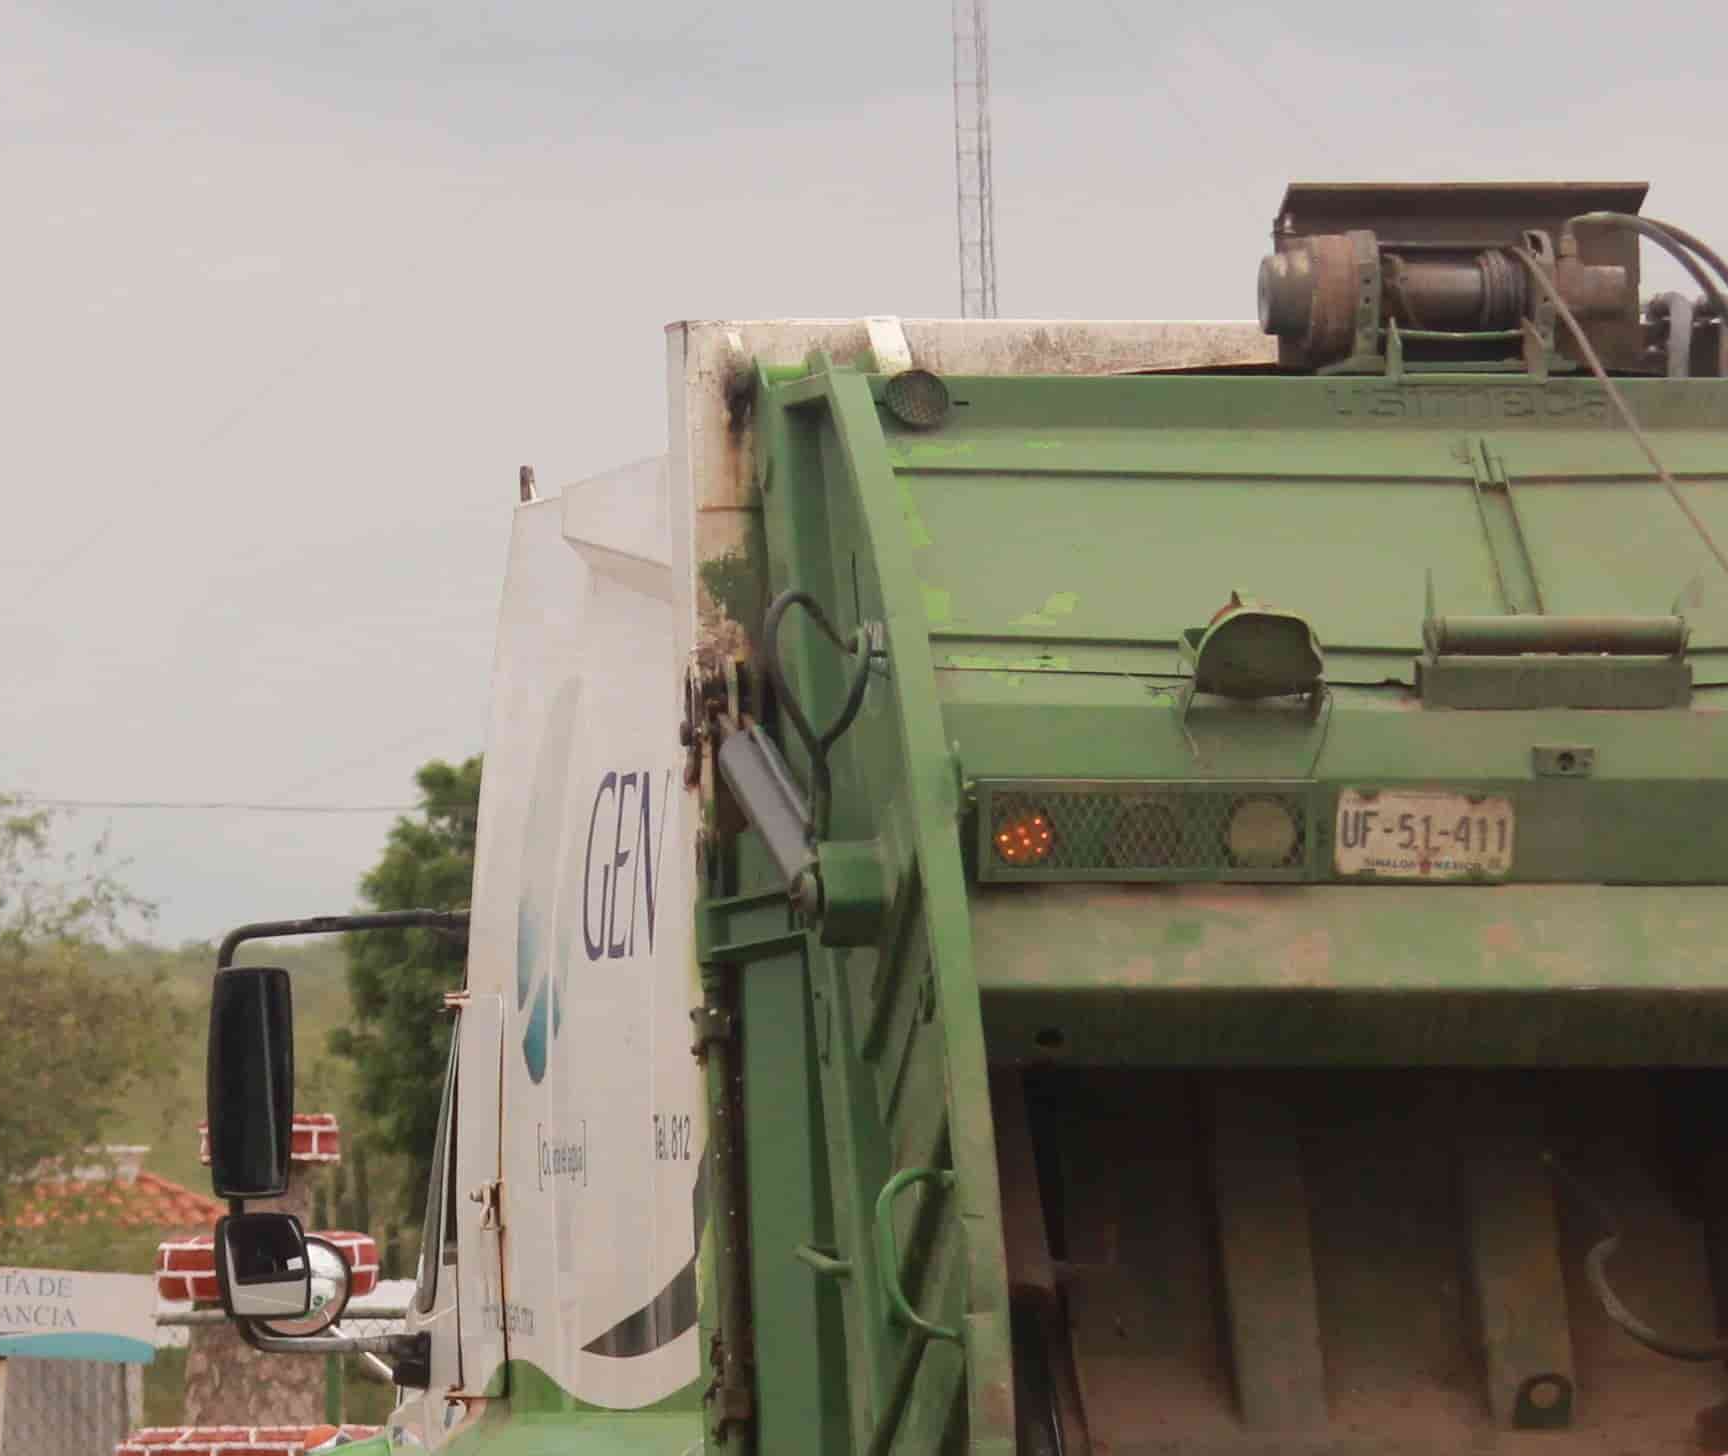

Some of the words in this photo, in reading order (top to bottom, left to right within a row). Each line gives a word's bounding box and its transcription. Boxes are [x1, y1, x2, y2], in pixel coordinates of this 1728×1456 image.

[1340, 809, 1508, 854] UF-51-411
[583, 767, 671, 962] GEN
[37, 1275, 73, 1299] DE
